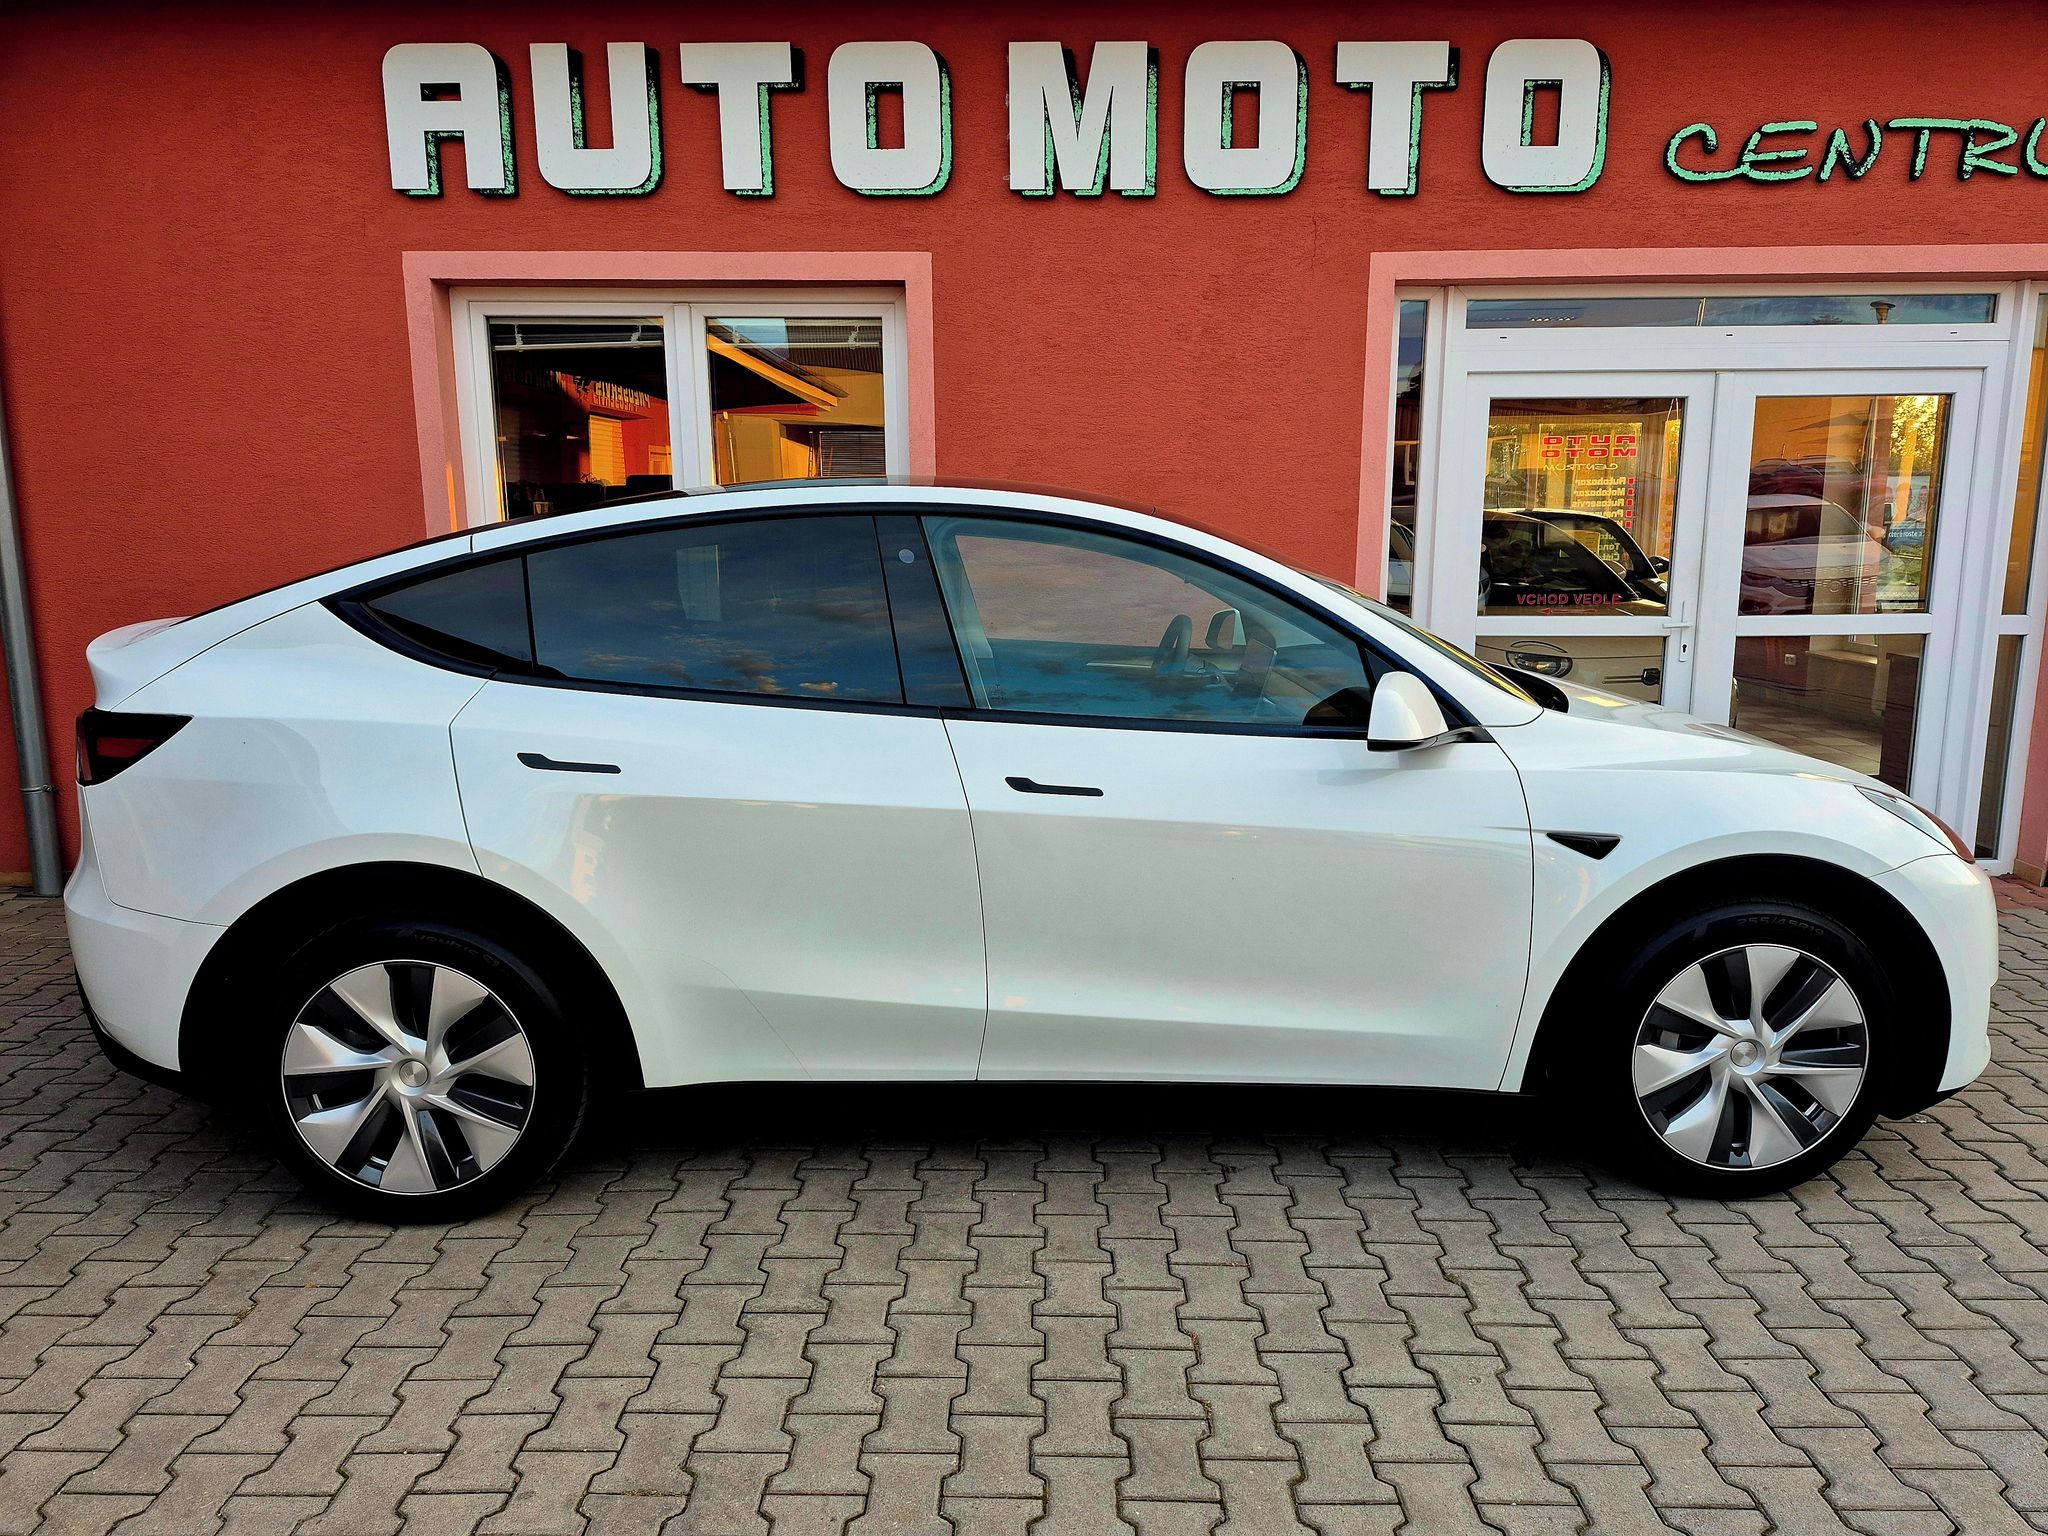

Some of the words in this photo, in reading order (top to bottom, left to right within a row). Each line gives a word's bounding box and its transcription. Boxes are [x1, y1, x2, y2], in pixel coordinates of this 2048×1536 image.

[381, 40, 953, 197] AUTO
[1006, 37, 1612, 197] MOTO
[1516, 593, 1570, 605] VCHOD
[1573, 593, 1622, 606] VEDLE
